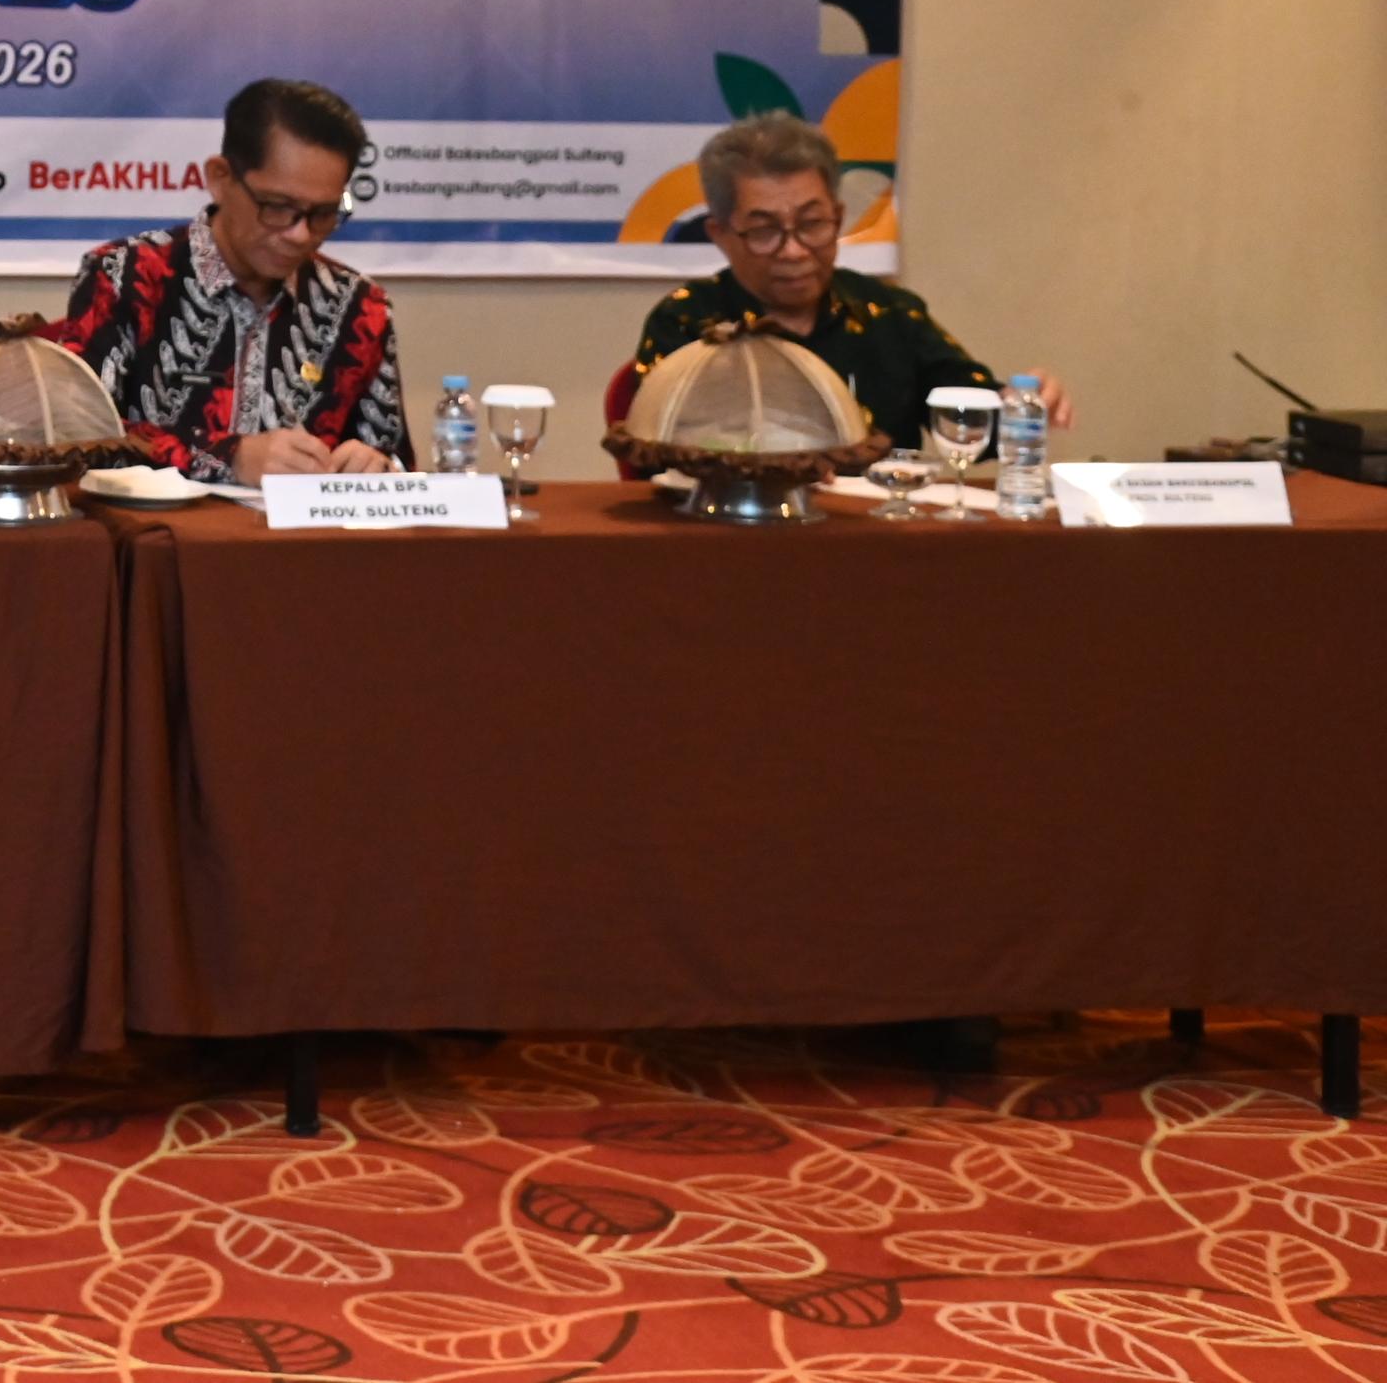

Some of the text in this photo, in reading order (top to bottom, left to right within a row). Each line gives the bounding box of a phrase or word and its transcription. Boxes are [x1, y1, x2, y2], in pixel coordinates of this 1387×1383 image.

[383, 144, 625, 166] Official Bakesbangpol Sulteng
[319, 481, 429, 493] KEPALA BPS
[309, 504, 449, 518] PROV. SULTENG
